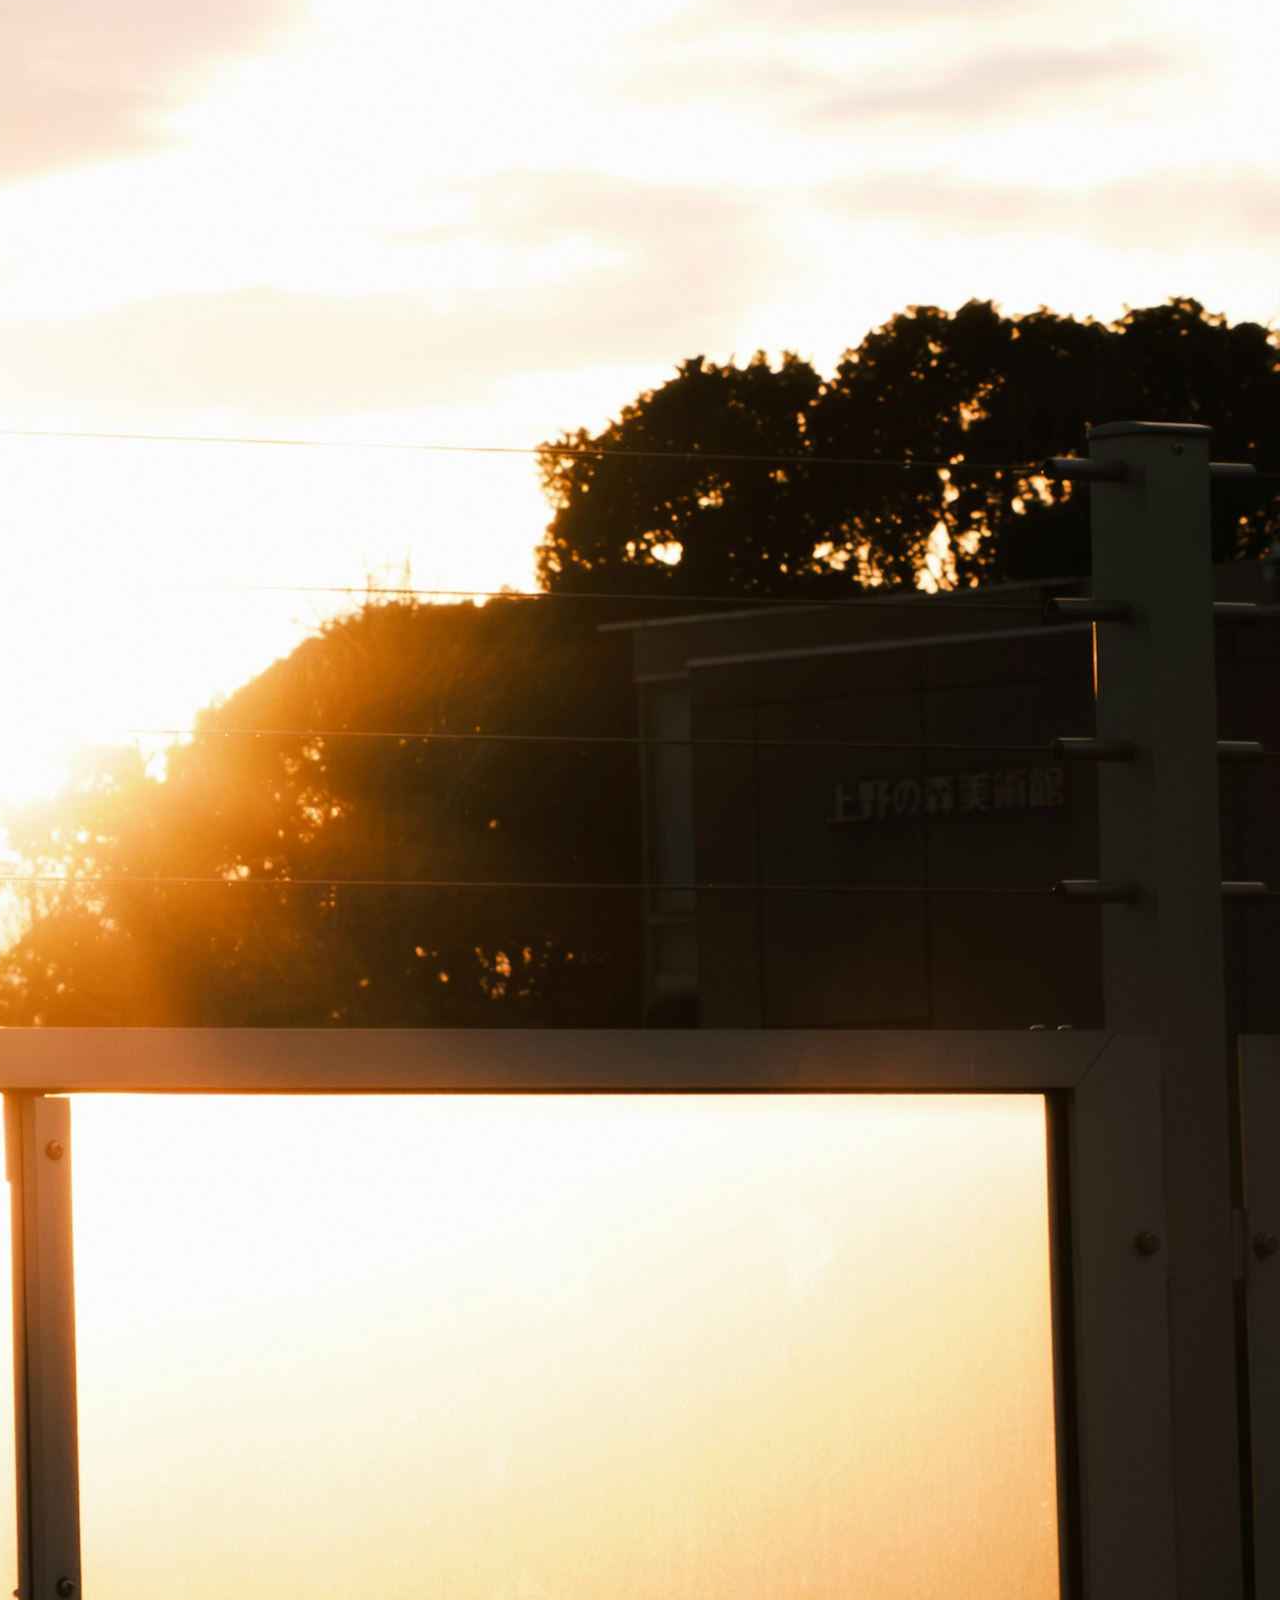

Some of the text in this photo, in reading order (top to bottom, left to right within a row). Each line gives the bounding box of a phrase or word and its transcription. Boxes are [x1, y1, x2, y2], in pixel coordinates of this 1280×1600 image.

[825, 766, 1065, 822] 上野の森美術館
